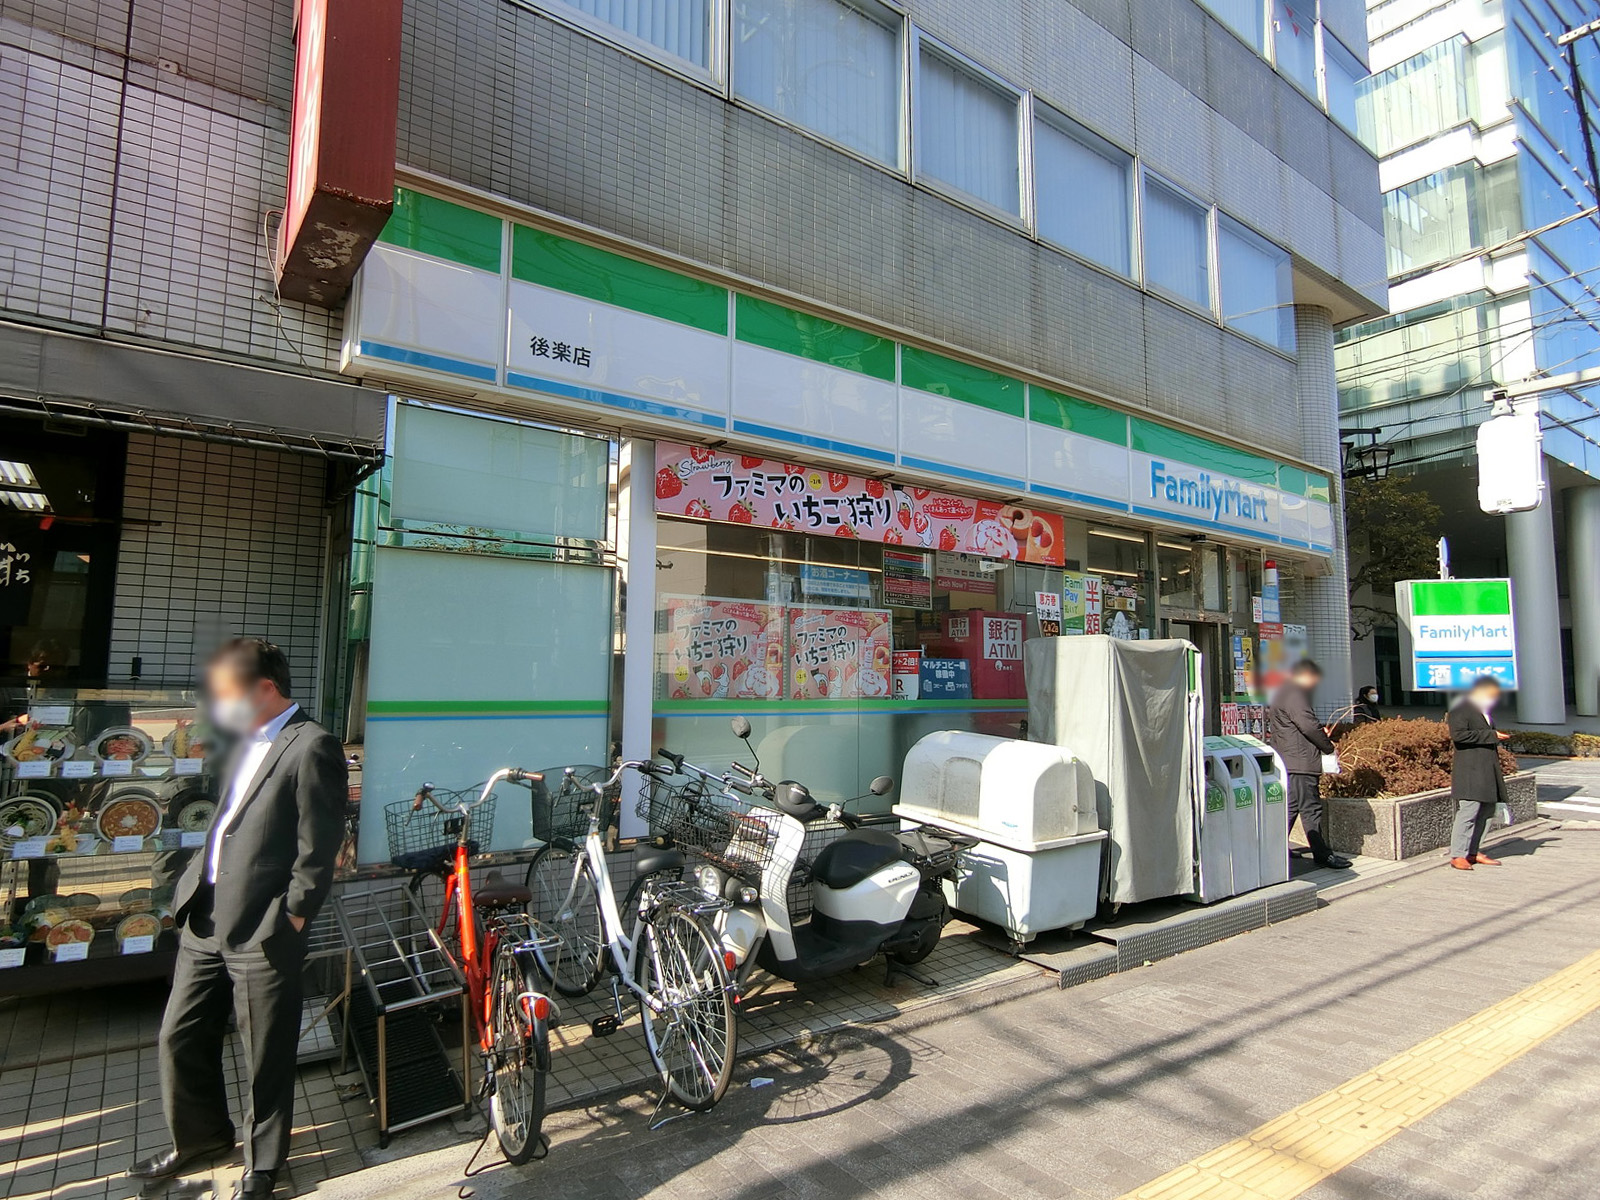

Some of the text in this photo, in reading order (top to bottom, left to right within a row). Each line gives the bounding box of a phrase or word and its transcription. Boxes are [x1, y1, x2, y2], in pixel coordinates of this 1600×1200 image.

[530, 336, 591, 367] 後楽店
[679, 456, 733, 477] Strawberry
[713, 473, 805, 498] ファミマの
[1150, 460, 1268, 522] FamilyMart
[775, 493, 892, 528] いちご狩り
[811, 567, 859, 580] お酒コーナー
[1065, 575, 1082, 589] Fami
[1064, 589, 1079, 603] Pay
[677, 620, 737, 639] ファミマの
[797, 626, 847, 645] ファミマの
[951, 629, 967, 637] ATM
[989, 620, 1018, 641] 銀行
[1419, 624, 1508, 641] FamilyMart
[674, 634, 748, 661] いちご狩り
[795, 640, 856, 665] いちご狩り
[989, 643, 1017, 658] ATM
[1428, 664, 1452, 686] 酒
